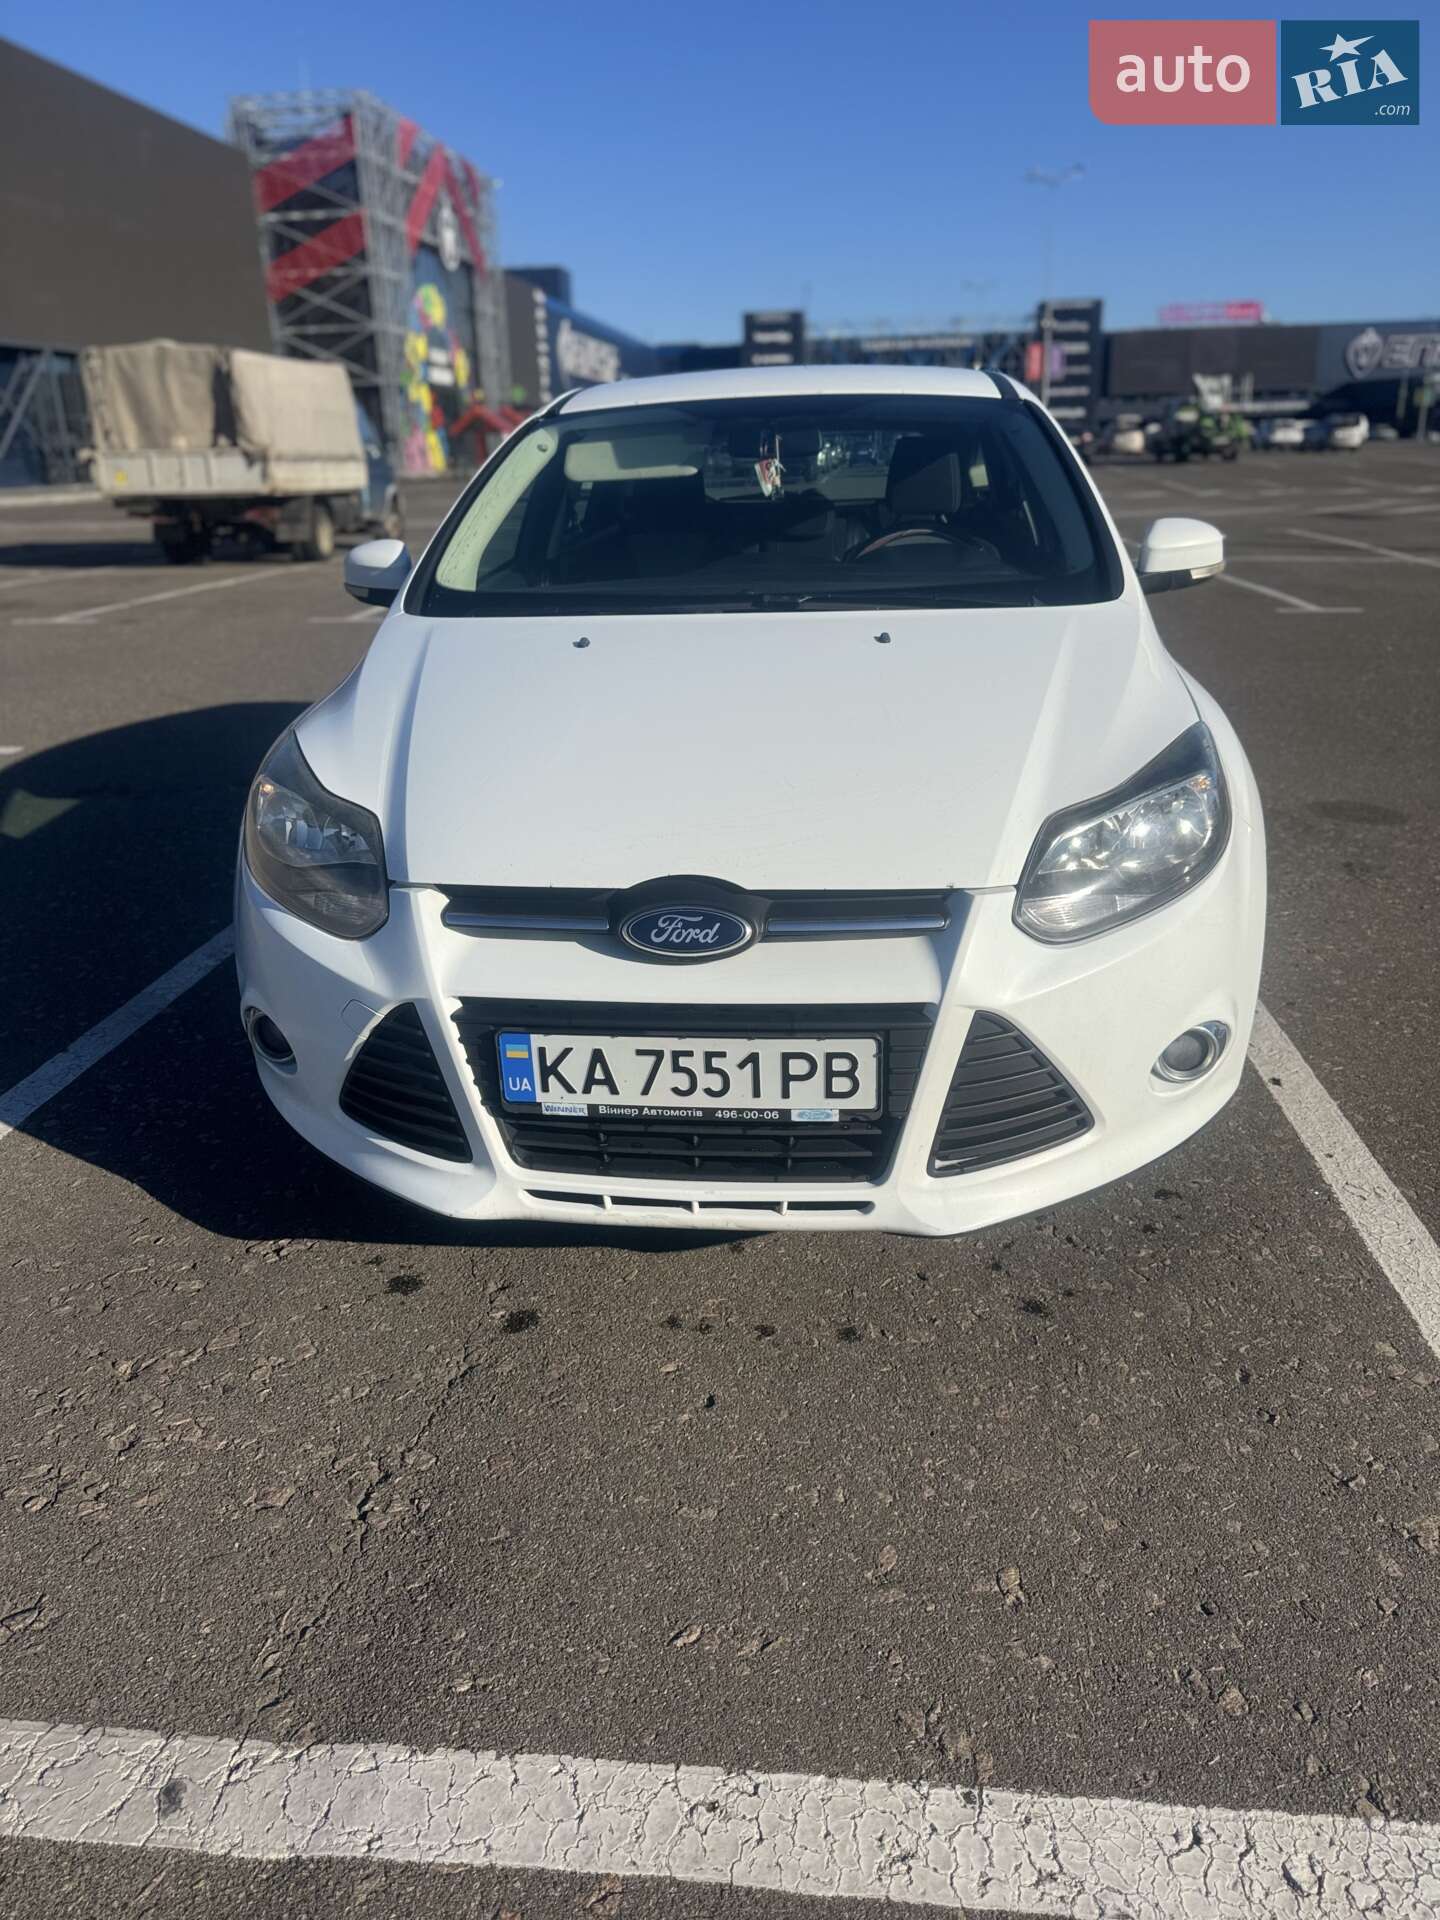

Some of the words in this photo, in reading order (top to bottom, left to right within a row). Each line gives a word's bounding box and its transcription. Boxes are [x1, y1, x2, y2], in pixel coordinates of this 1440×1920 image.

[650, 914, 721, 944] Ford
[537, 1046, 620, 1096] KA
[635, 1048, 761, 1099] 7551
[780, 1051, 861, 1100] PB
[509, 1077, 532, 1092] UA
[599, 1105, 639, 1118] Віннер
[642, 1107, 703, 1118] Автомотів
[715, 1110, 780, 1120] 496-00-06
